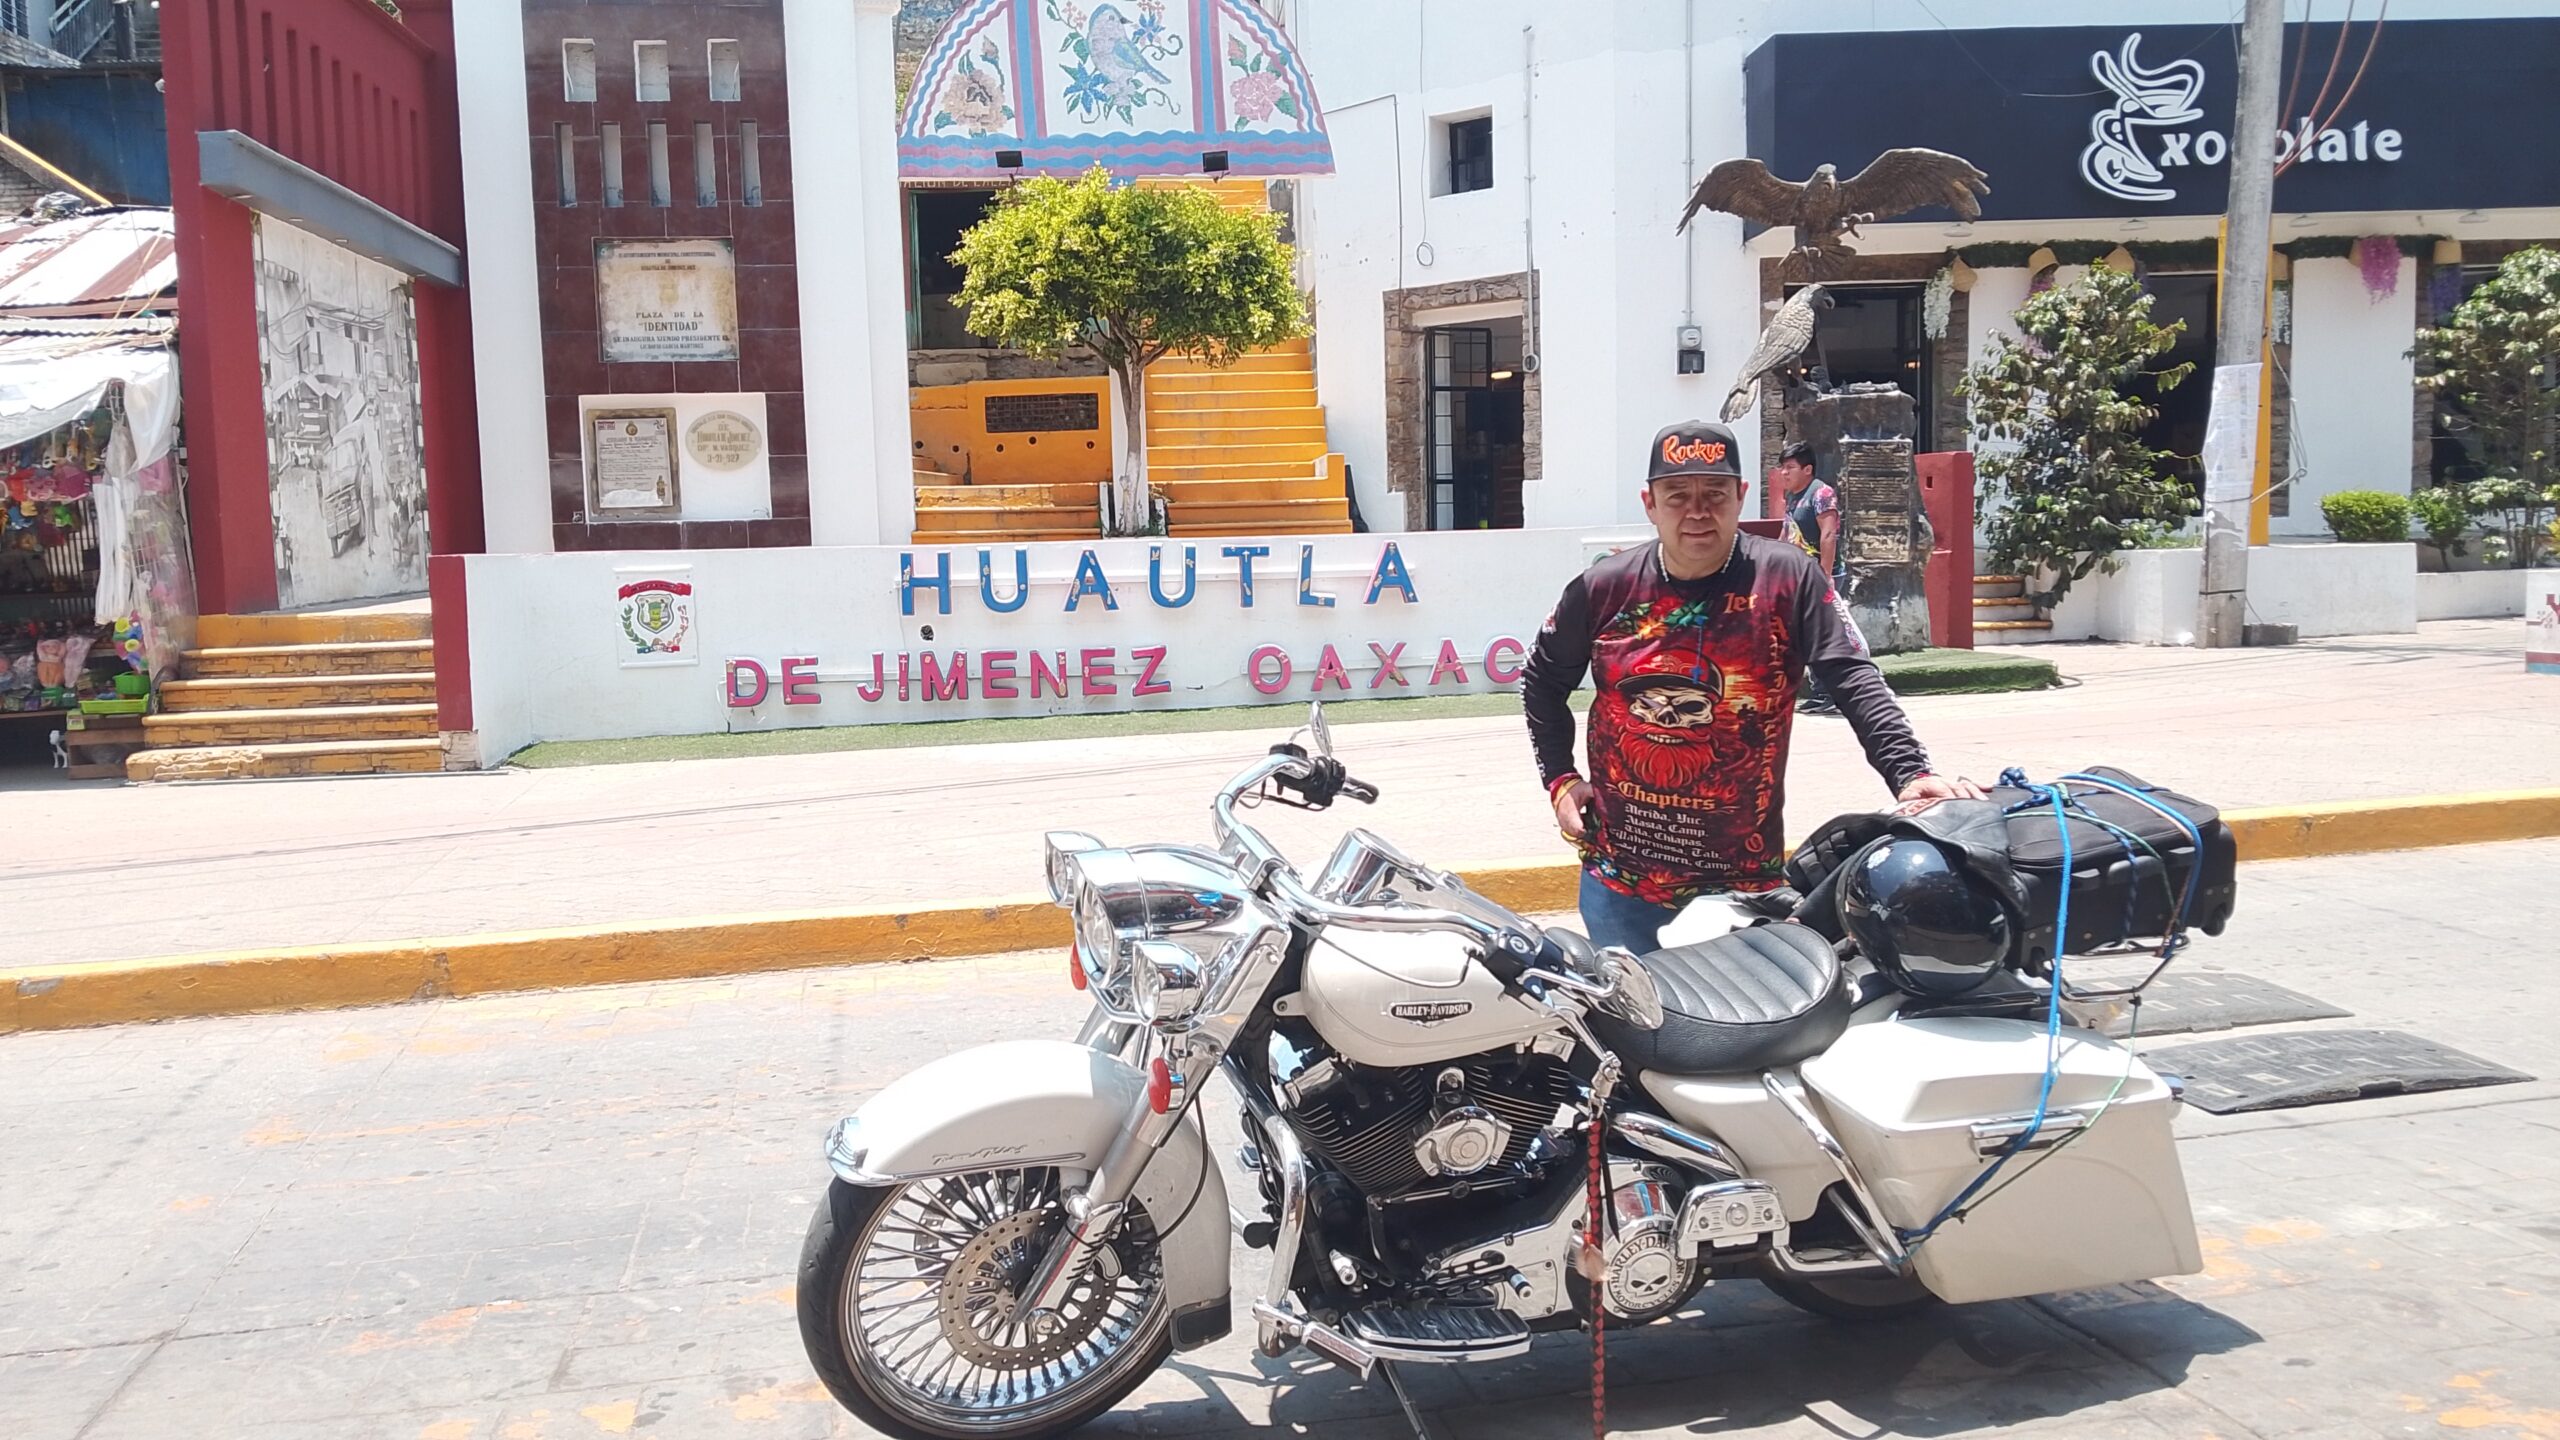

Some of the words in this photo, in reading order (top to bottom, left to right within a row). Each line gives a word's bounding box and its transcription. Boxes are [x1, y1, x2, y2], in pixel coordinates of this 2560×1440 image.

[2161, 116, 2402, 166] xoolate
[636, 311, 663, 319] PLAZA
[1663, 435, 1726, 464] Rocky's
[900, 539, 1420, 616] HUAUTLA
[725, 656, 821, 708] DE
[856, 644, 1172, 701] JIMENEZ
[1247, 635, 1525, 695] OAXAC
[1618, 780, 1716, 811] Chapters
[1395, 1003, 1469, 1016] HARLEY-DAVIDSON
[1610, 1235, 1685, 1285] HARLEY-DAVON
